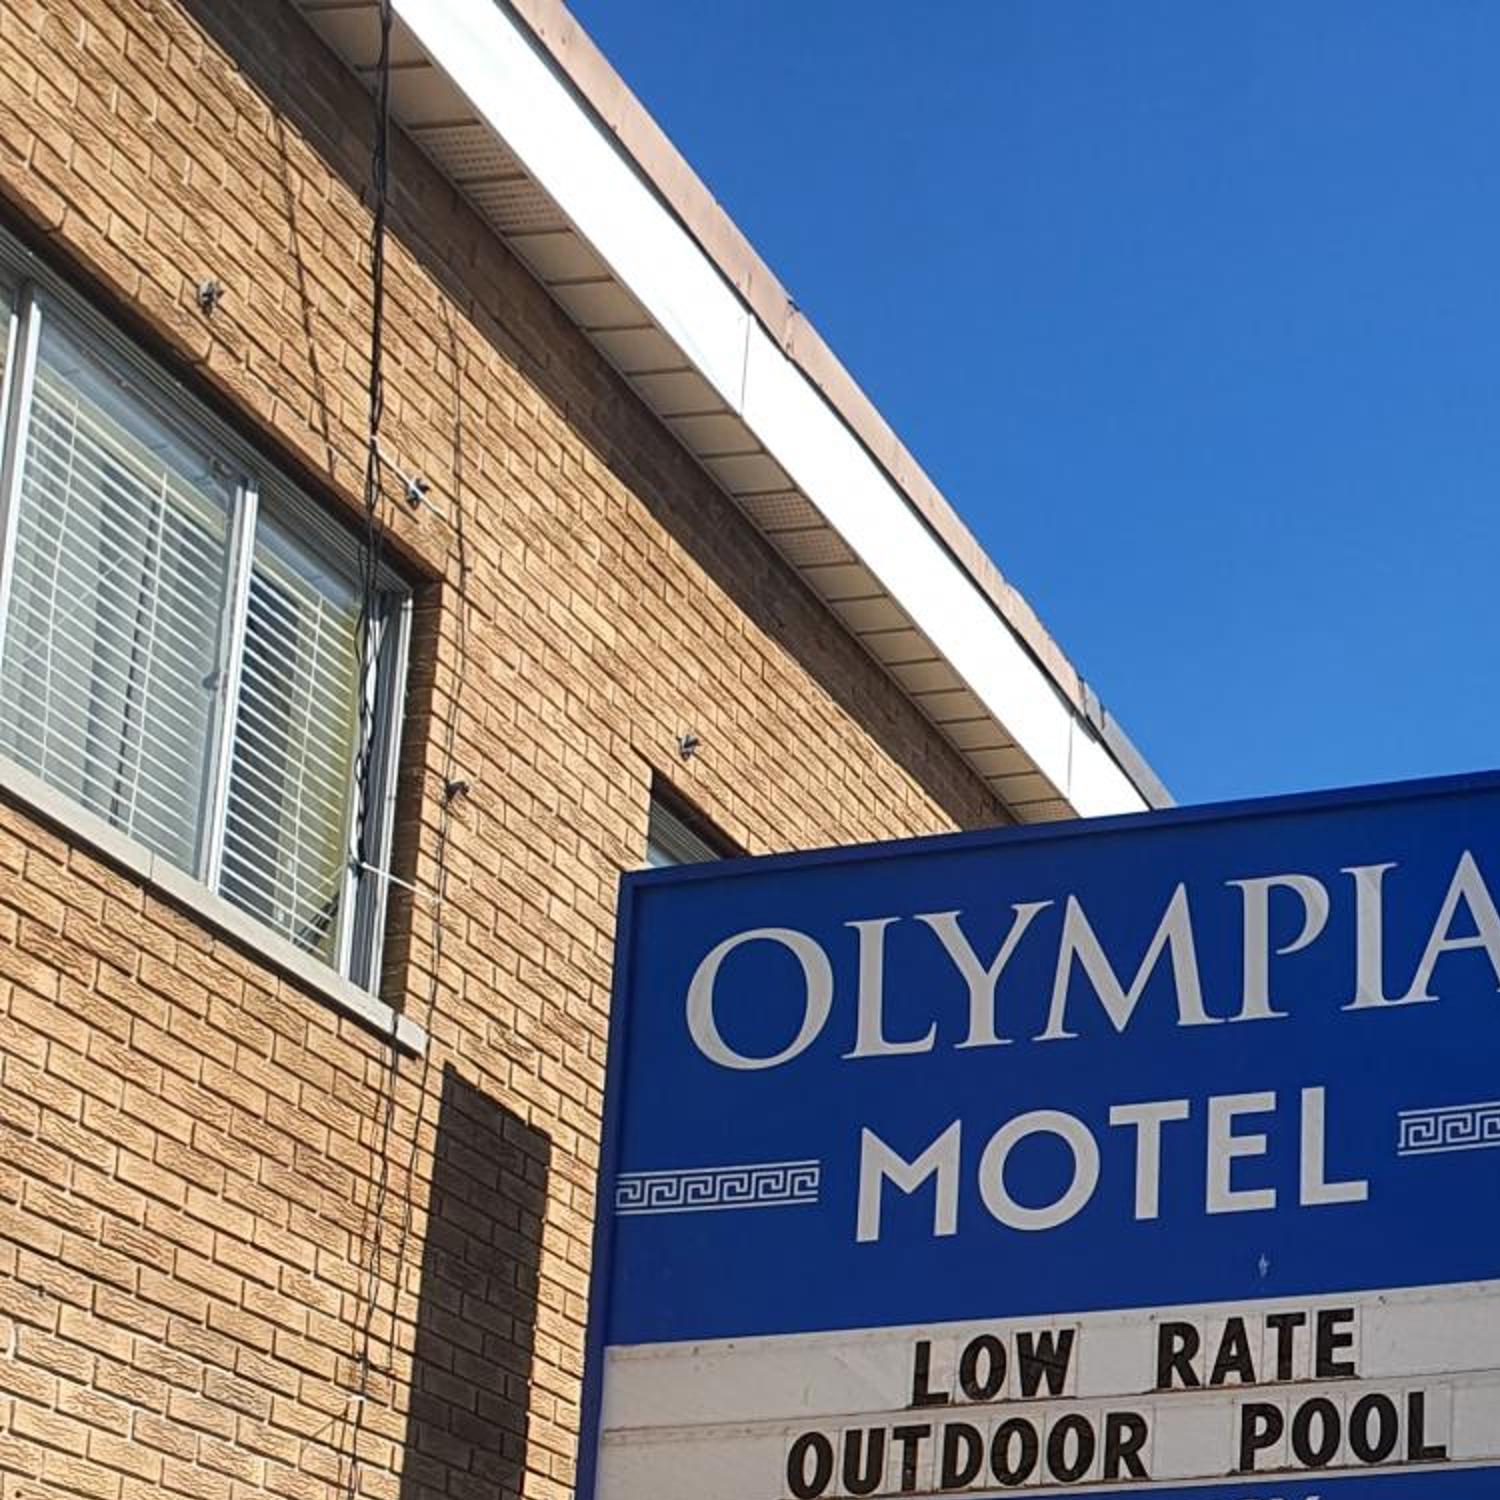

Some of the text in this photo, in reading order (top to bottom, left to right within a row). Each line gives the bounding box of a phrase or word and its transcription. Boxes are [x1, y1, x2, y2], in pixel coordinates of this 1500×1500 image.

[854, 1086, 1370, 1243] MOTEL
[911, 1307, 1357, 1406] LOW RATE
[1239, 1392, 1448, 1473] POOL
